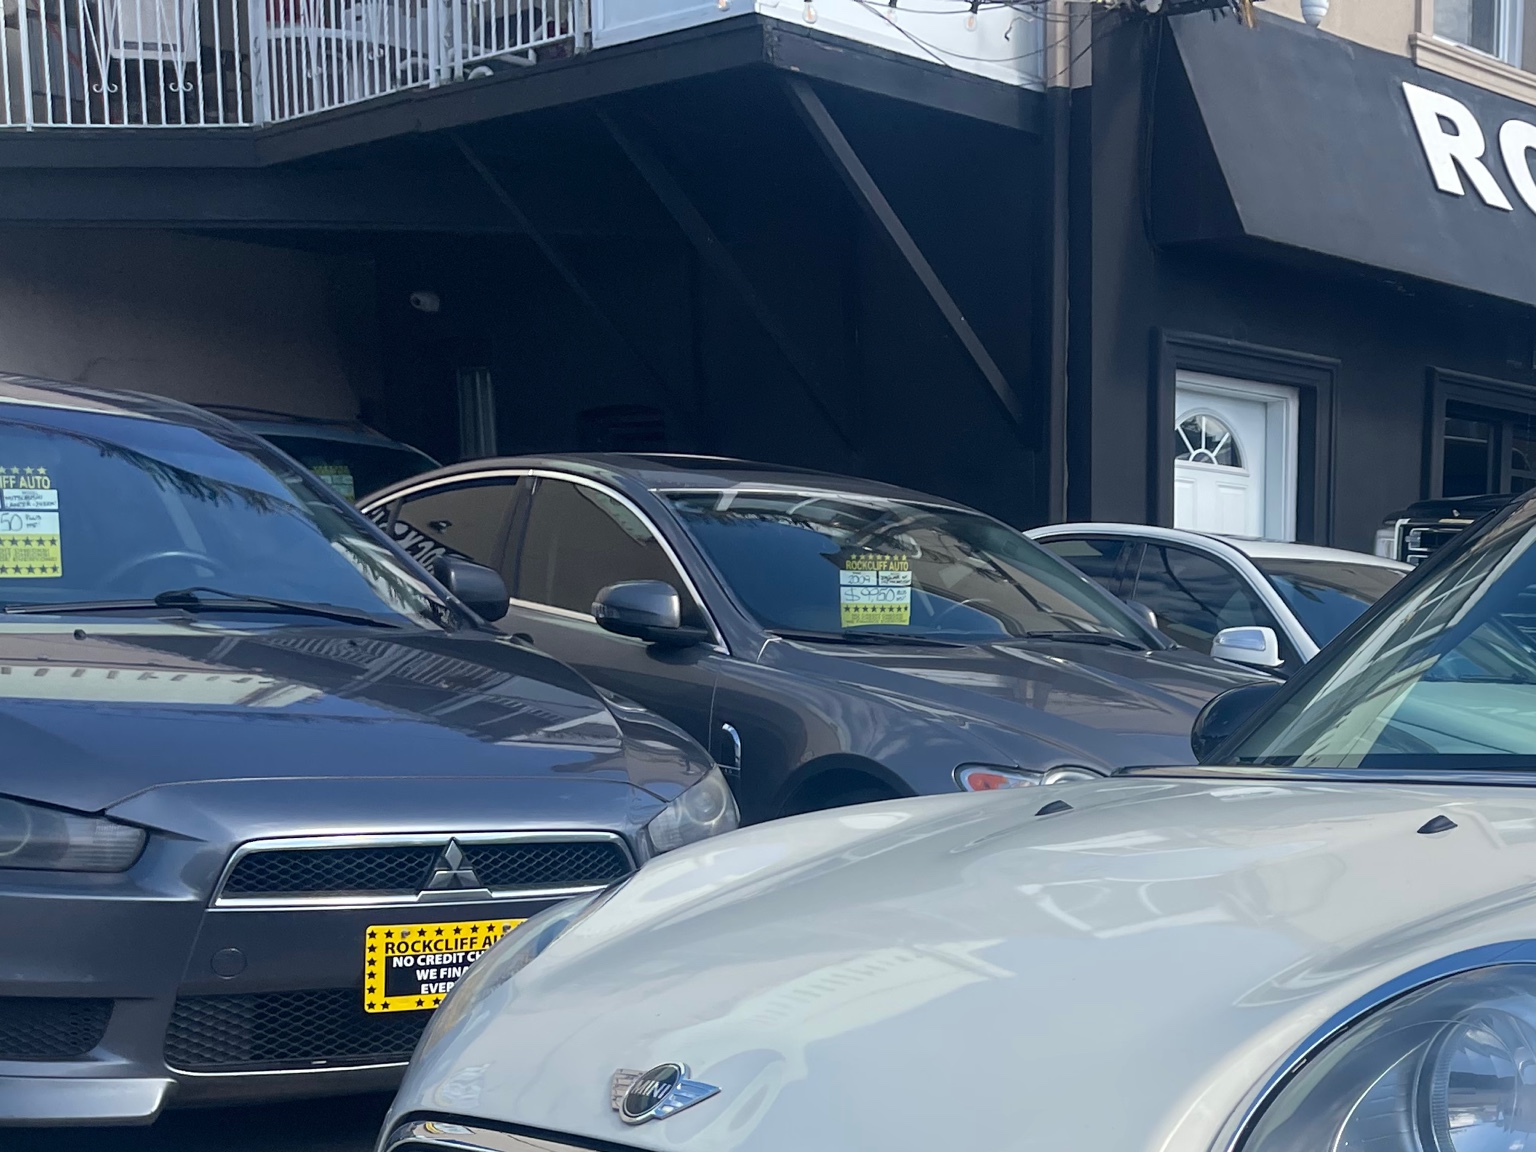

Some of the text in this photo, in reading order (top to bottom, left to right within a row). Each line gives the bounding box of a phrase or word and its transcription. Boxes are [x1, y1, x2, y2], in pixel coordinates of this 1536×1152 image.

[20, 475, 51, 489] AUTO
[0, 512, 23, 531] 50
[845, 560, 909, 571] ROCKCLIFF AUTO
[385, 936, 478, 954] ROCKCLIFF
[392, 955, 415, 968] NO
[417, 952, 465, 966] CREDIT
[416, 968, 438, 981] WE
[631, 1079, 672, 1099] MINI
